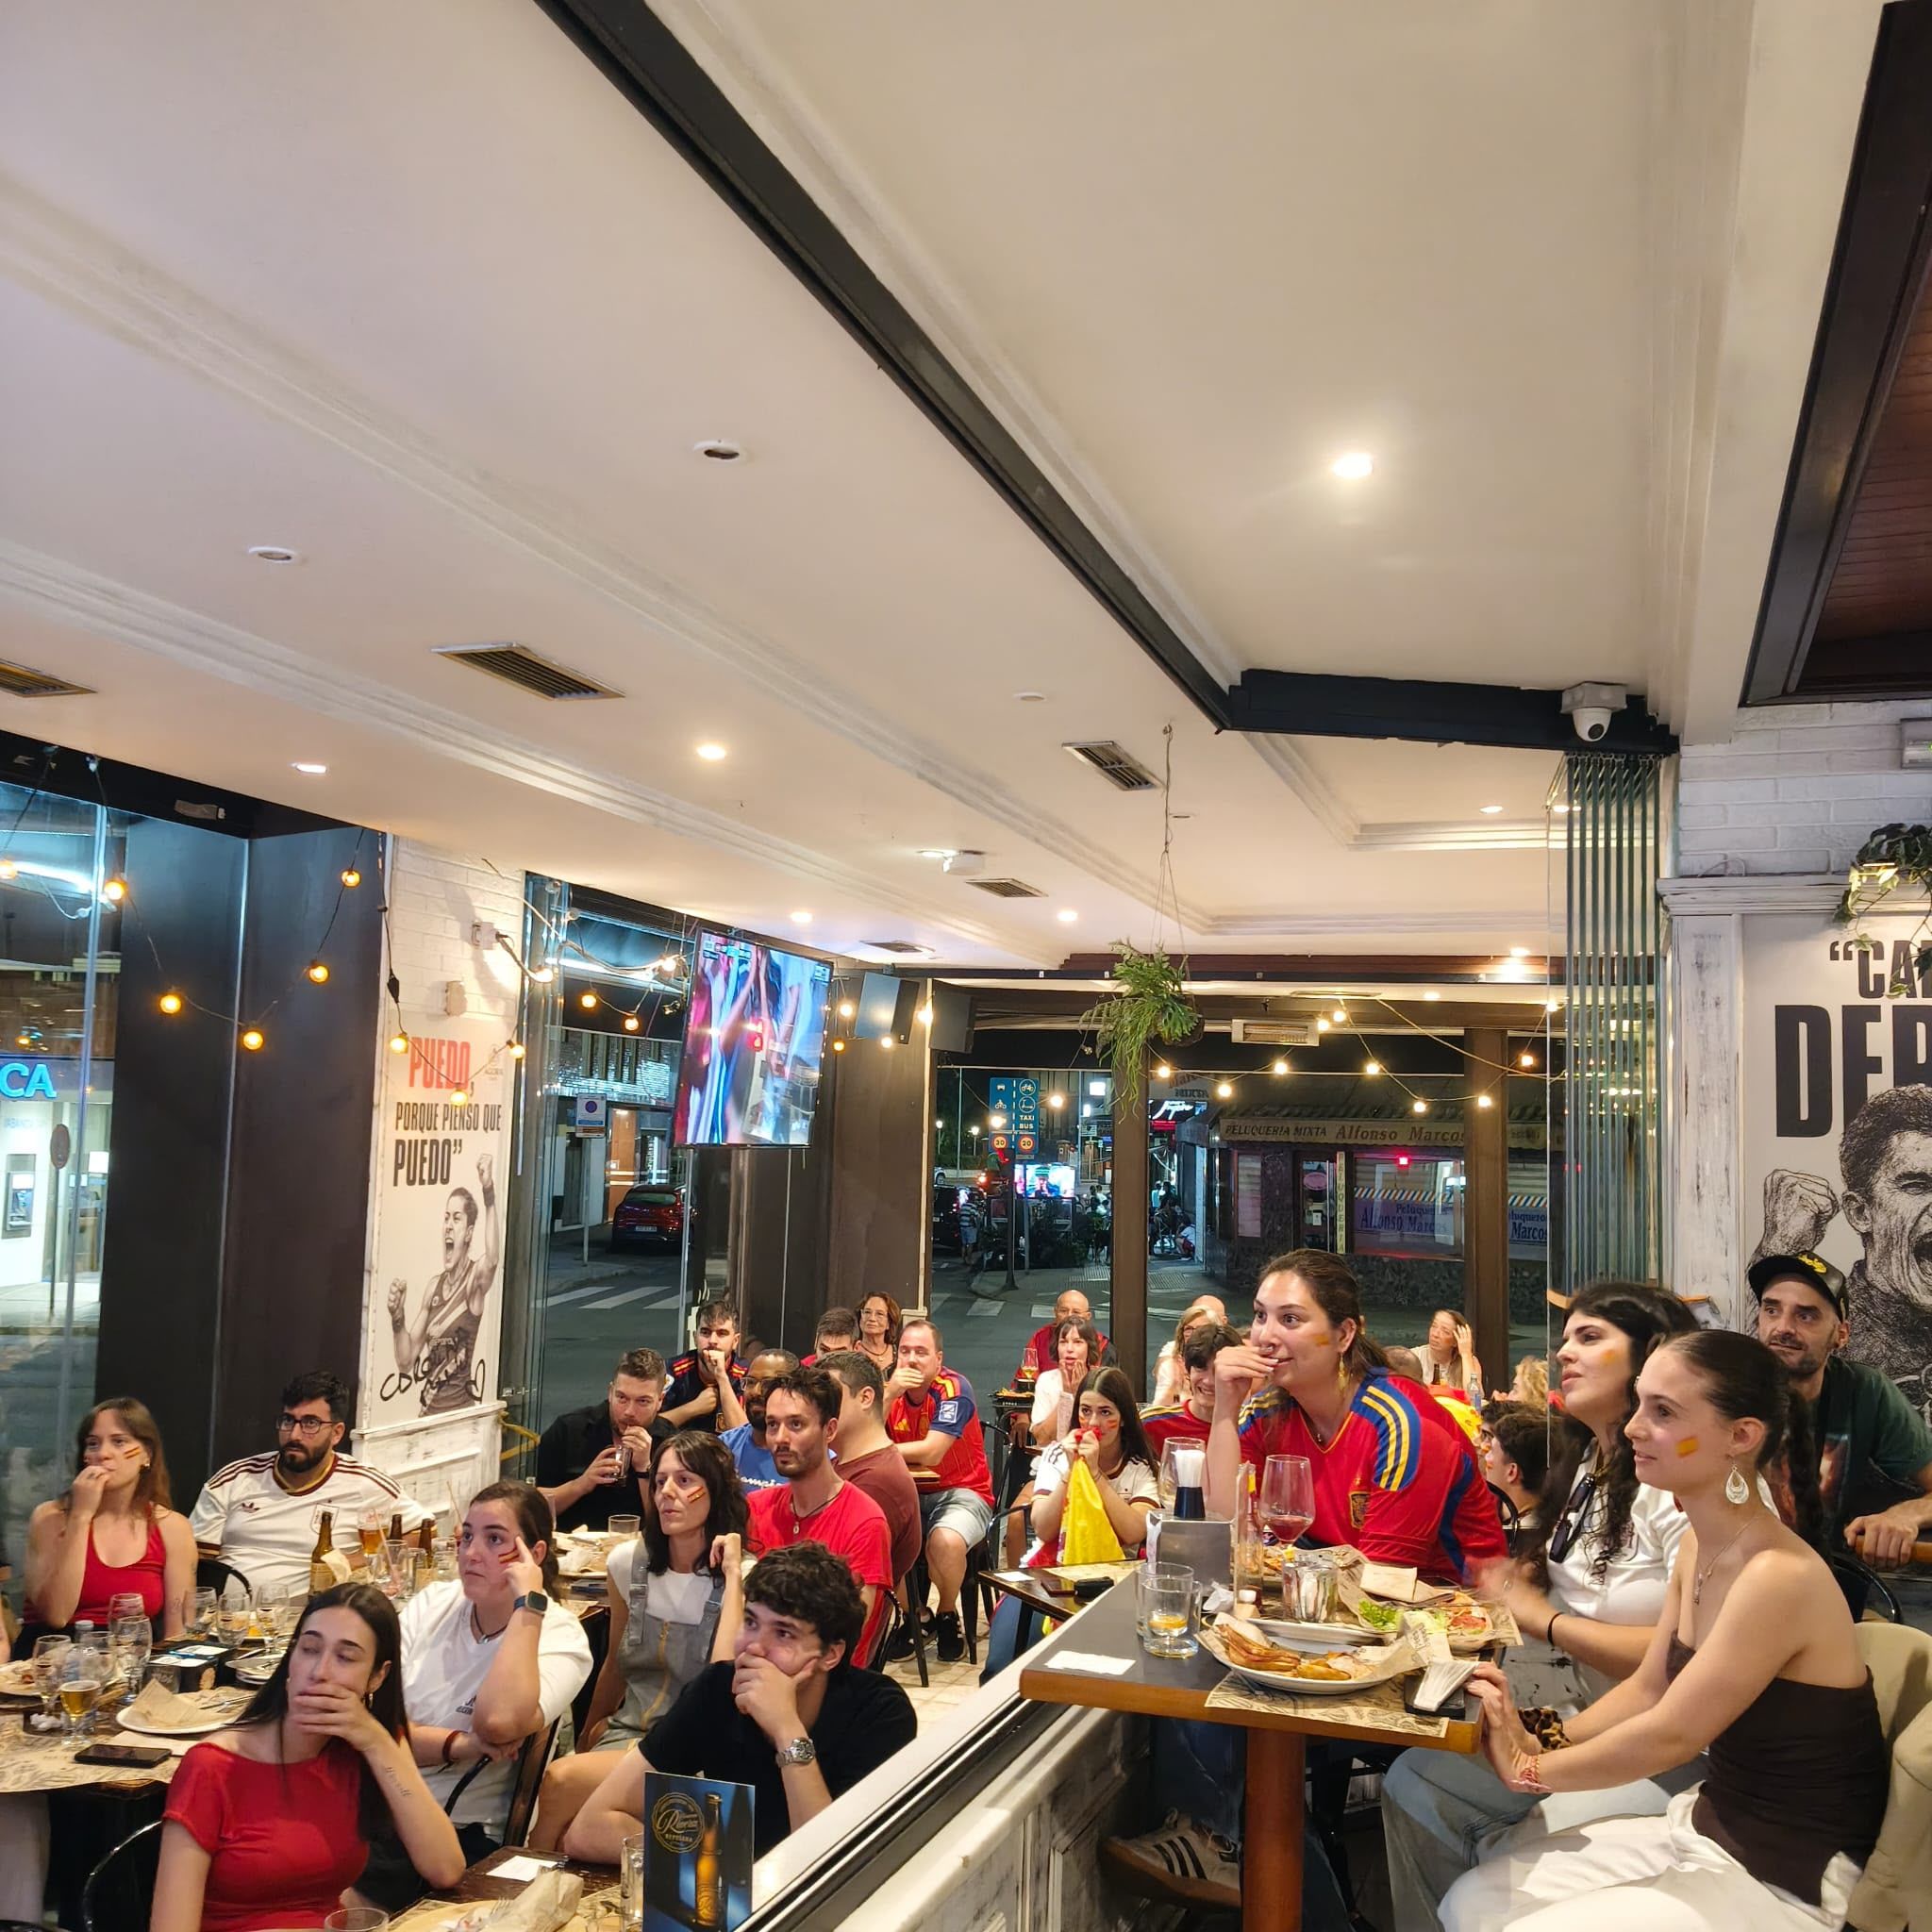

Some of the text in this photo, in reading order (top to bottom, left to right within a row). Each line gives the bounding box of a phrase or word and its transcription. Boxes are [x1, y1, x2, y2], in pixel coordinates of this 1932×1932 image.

[0, 1062, 57, 1098] CA
[395, 1102, 502, 1133] PORQUE PIENSO QUE
[1293, 1125, 1326, 1138] MIXTA
[1336, 1125, 1398, 1141] Alfonso
[392, 1139, 462, 1187] PUEDO”
[1508, 1210, 1548, 1223] luquero
